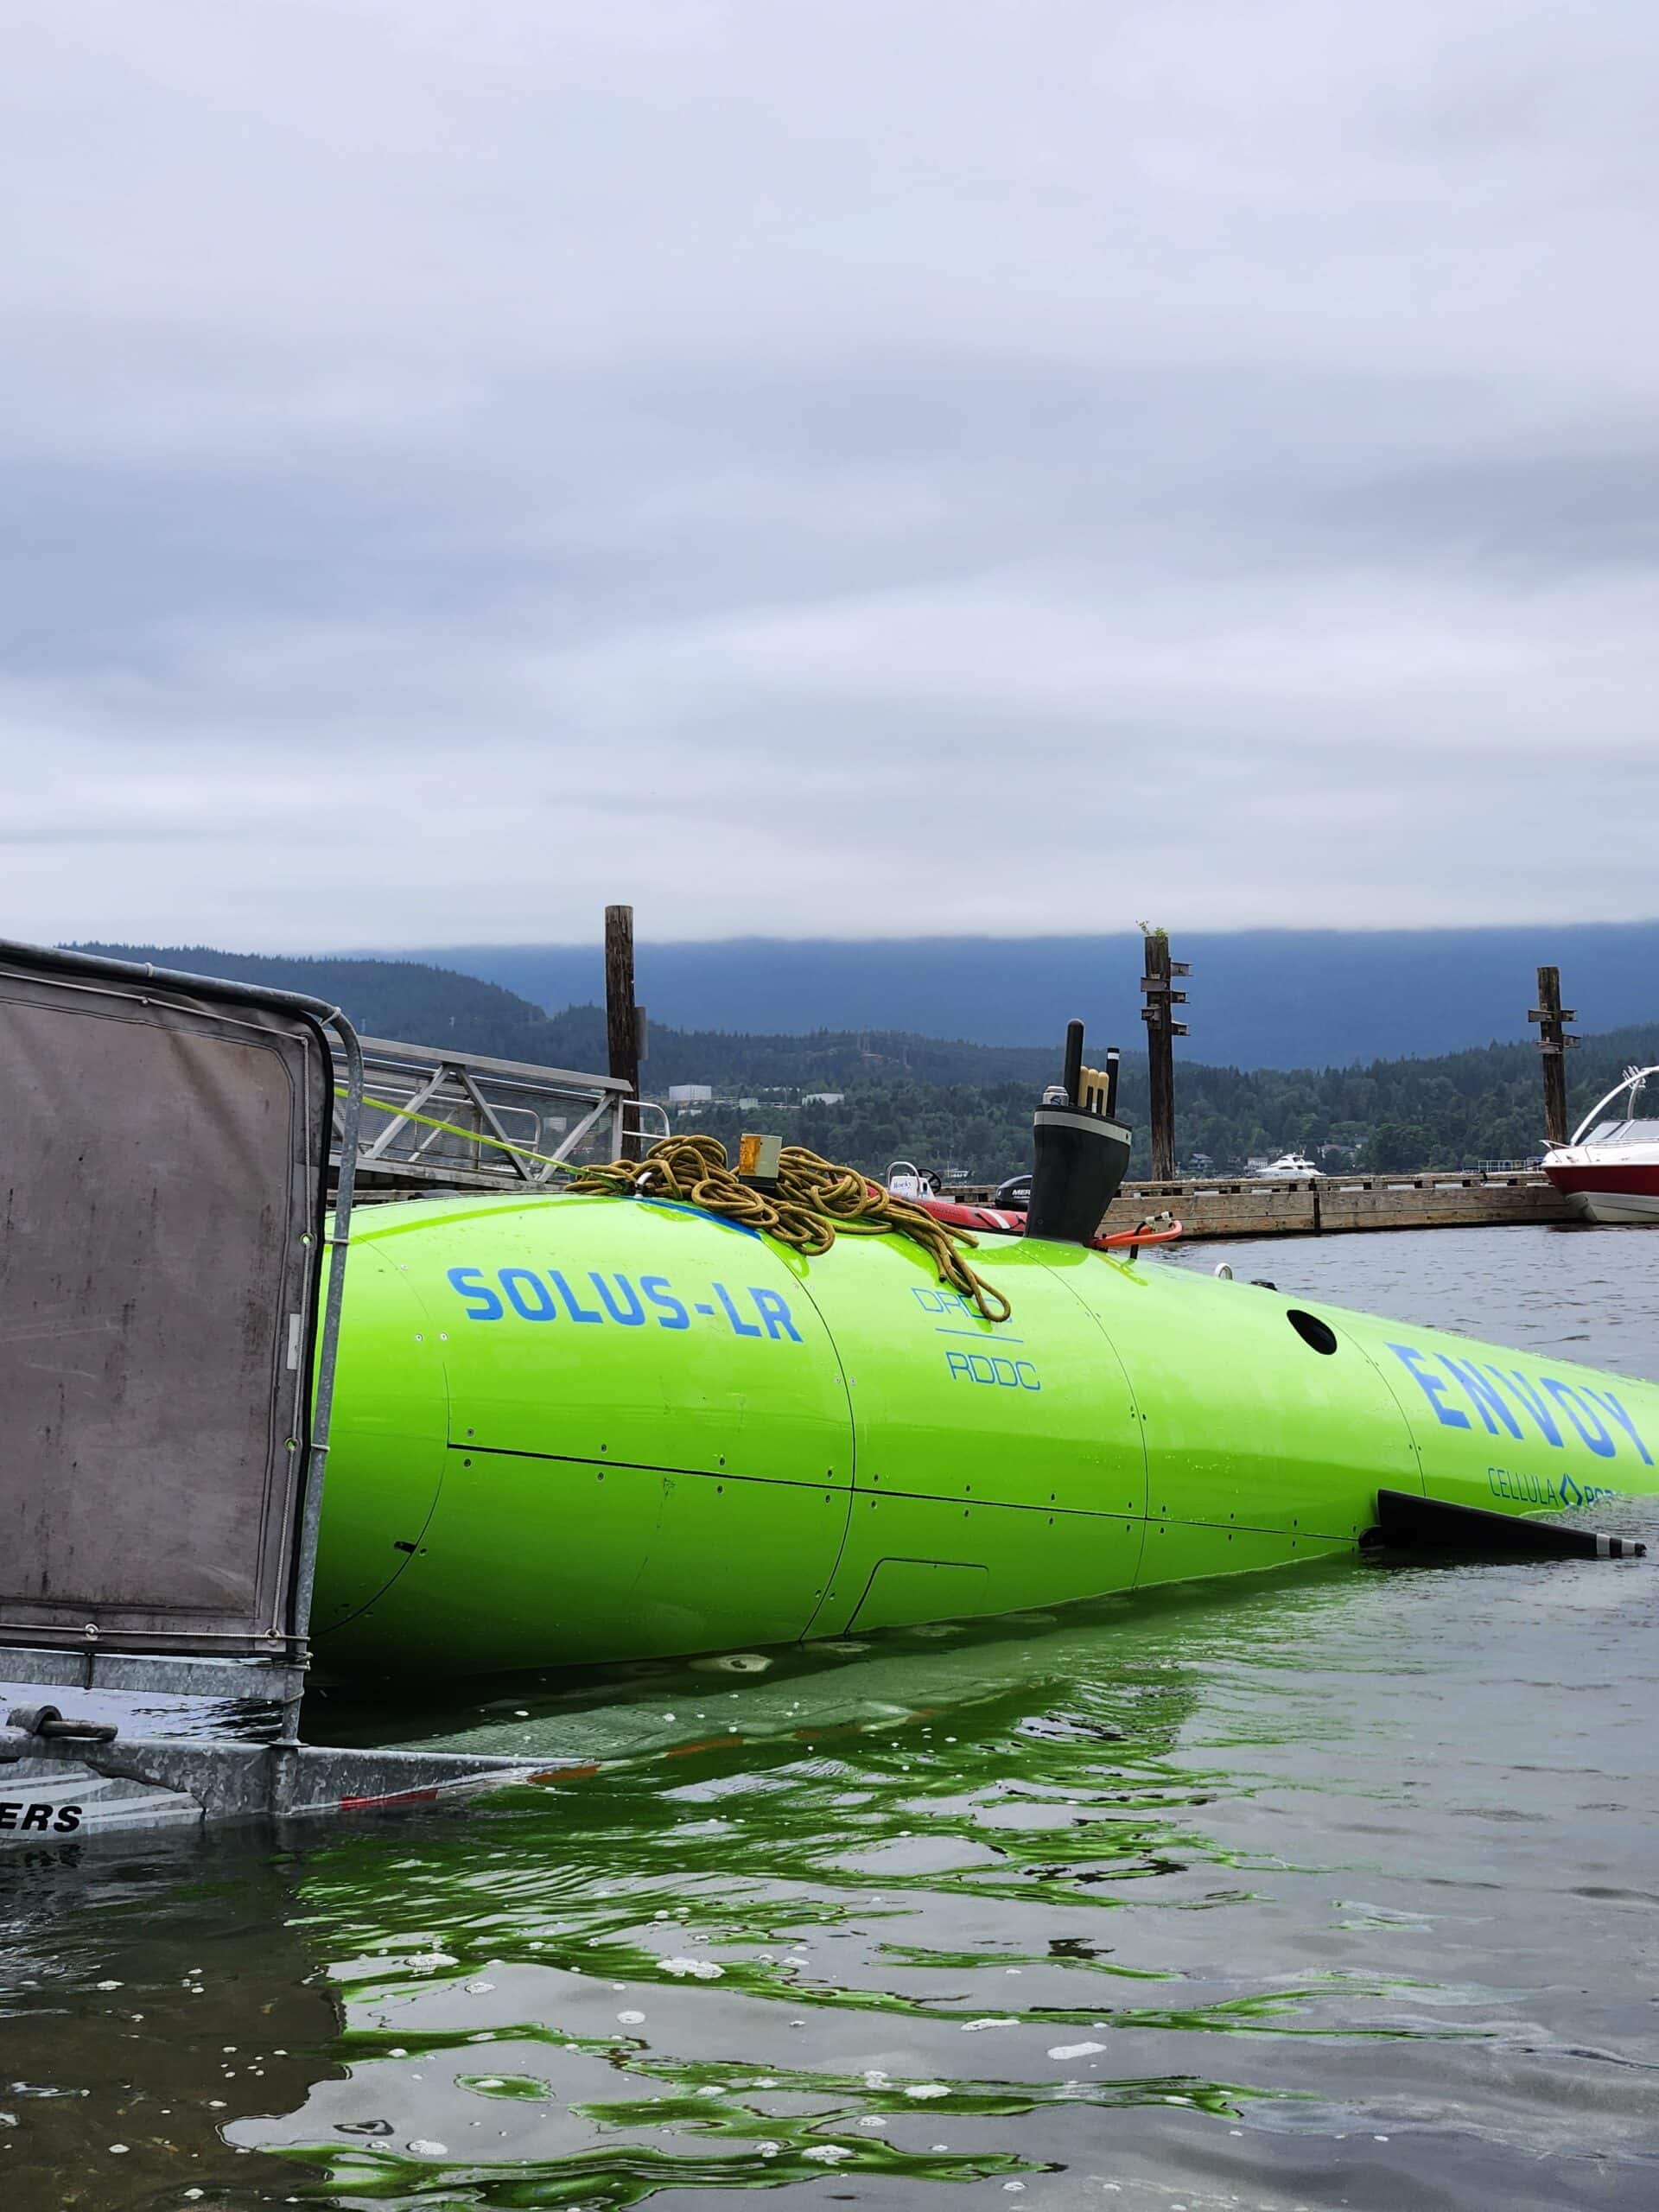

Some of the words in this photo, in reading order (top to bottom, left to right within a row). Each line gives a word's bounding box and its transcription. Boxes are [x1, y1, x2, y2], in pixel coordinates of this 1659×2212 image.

[447, 1267, 804, 1343] SOLUS-LR
[945, 1351, 1040, 1390] RDDC
[1382, 1341, 1655, 1465] ENVOY
[1488, 1467, 1560, 1506] CELLULA
[0, 1802, 83, 1833] ERS
